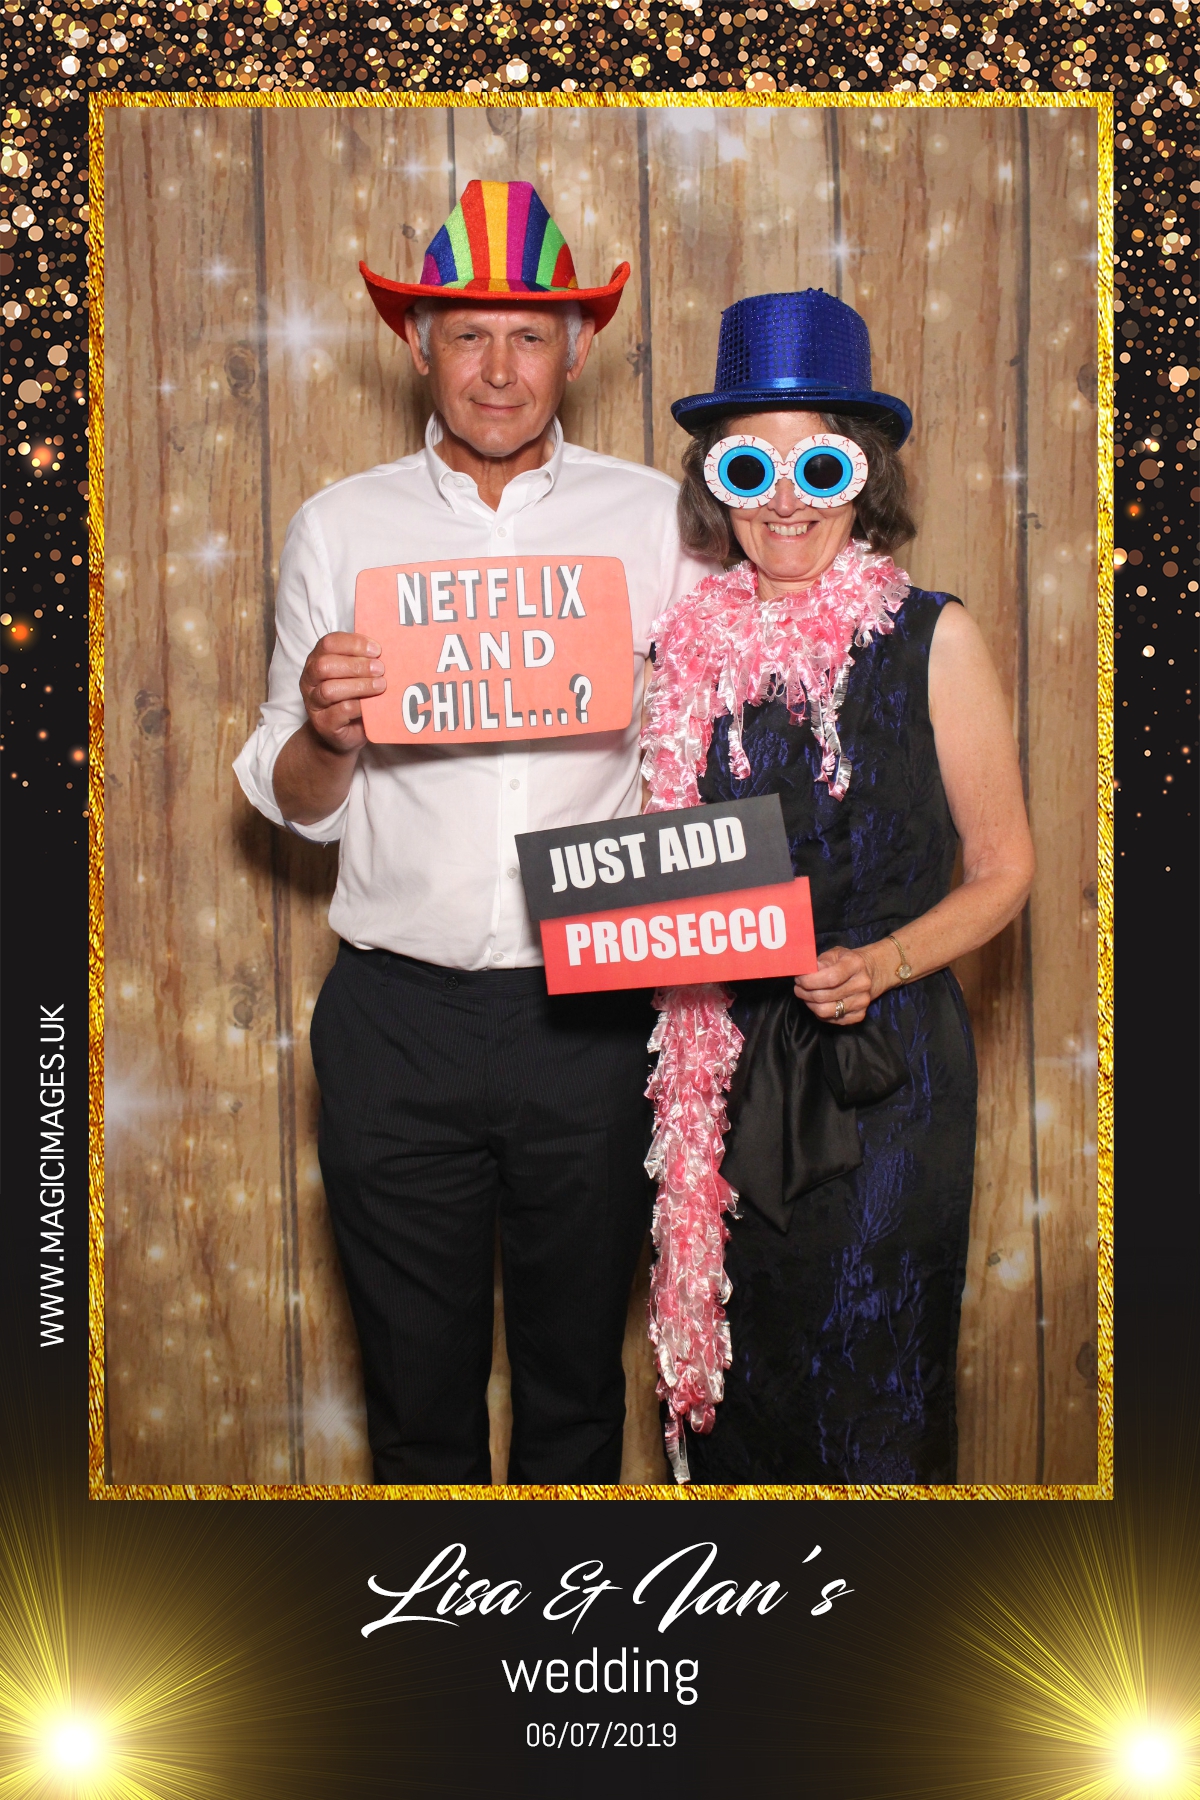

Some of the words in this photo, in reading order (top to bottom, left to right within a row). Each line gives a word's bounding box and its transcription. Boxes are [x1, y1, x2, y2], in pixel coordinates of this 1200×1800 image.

[396, 564, 587, 626] NETFLIX
[436, 629, 555, 673] AND
[401, 673, 593, 734] CHILL...?
[549, 832, 646, 893] JUST
[658, 816, 747, 874] ADD
[565, 905, 787, 966] PROSECCO
